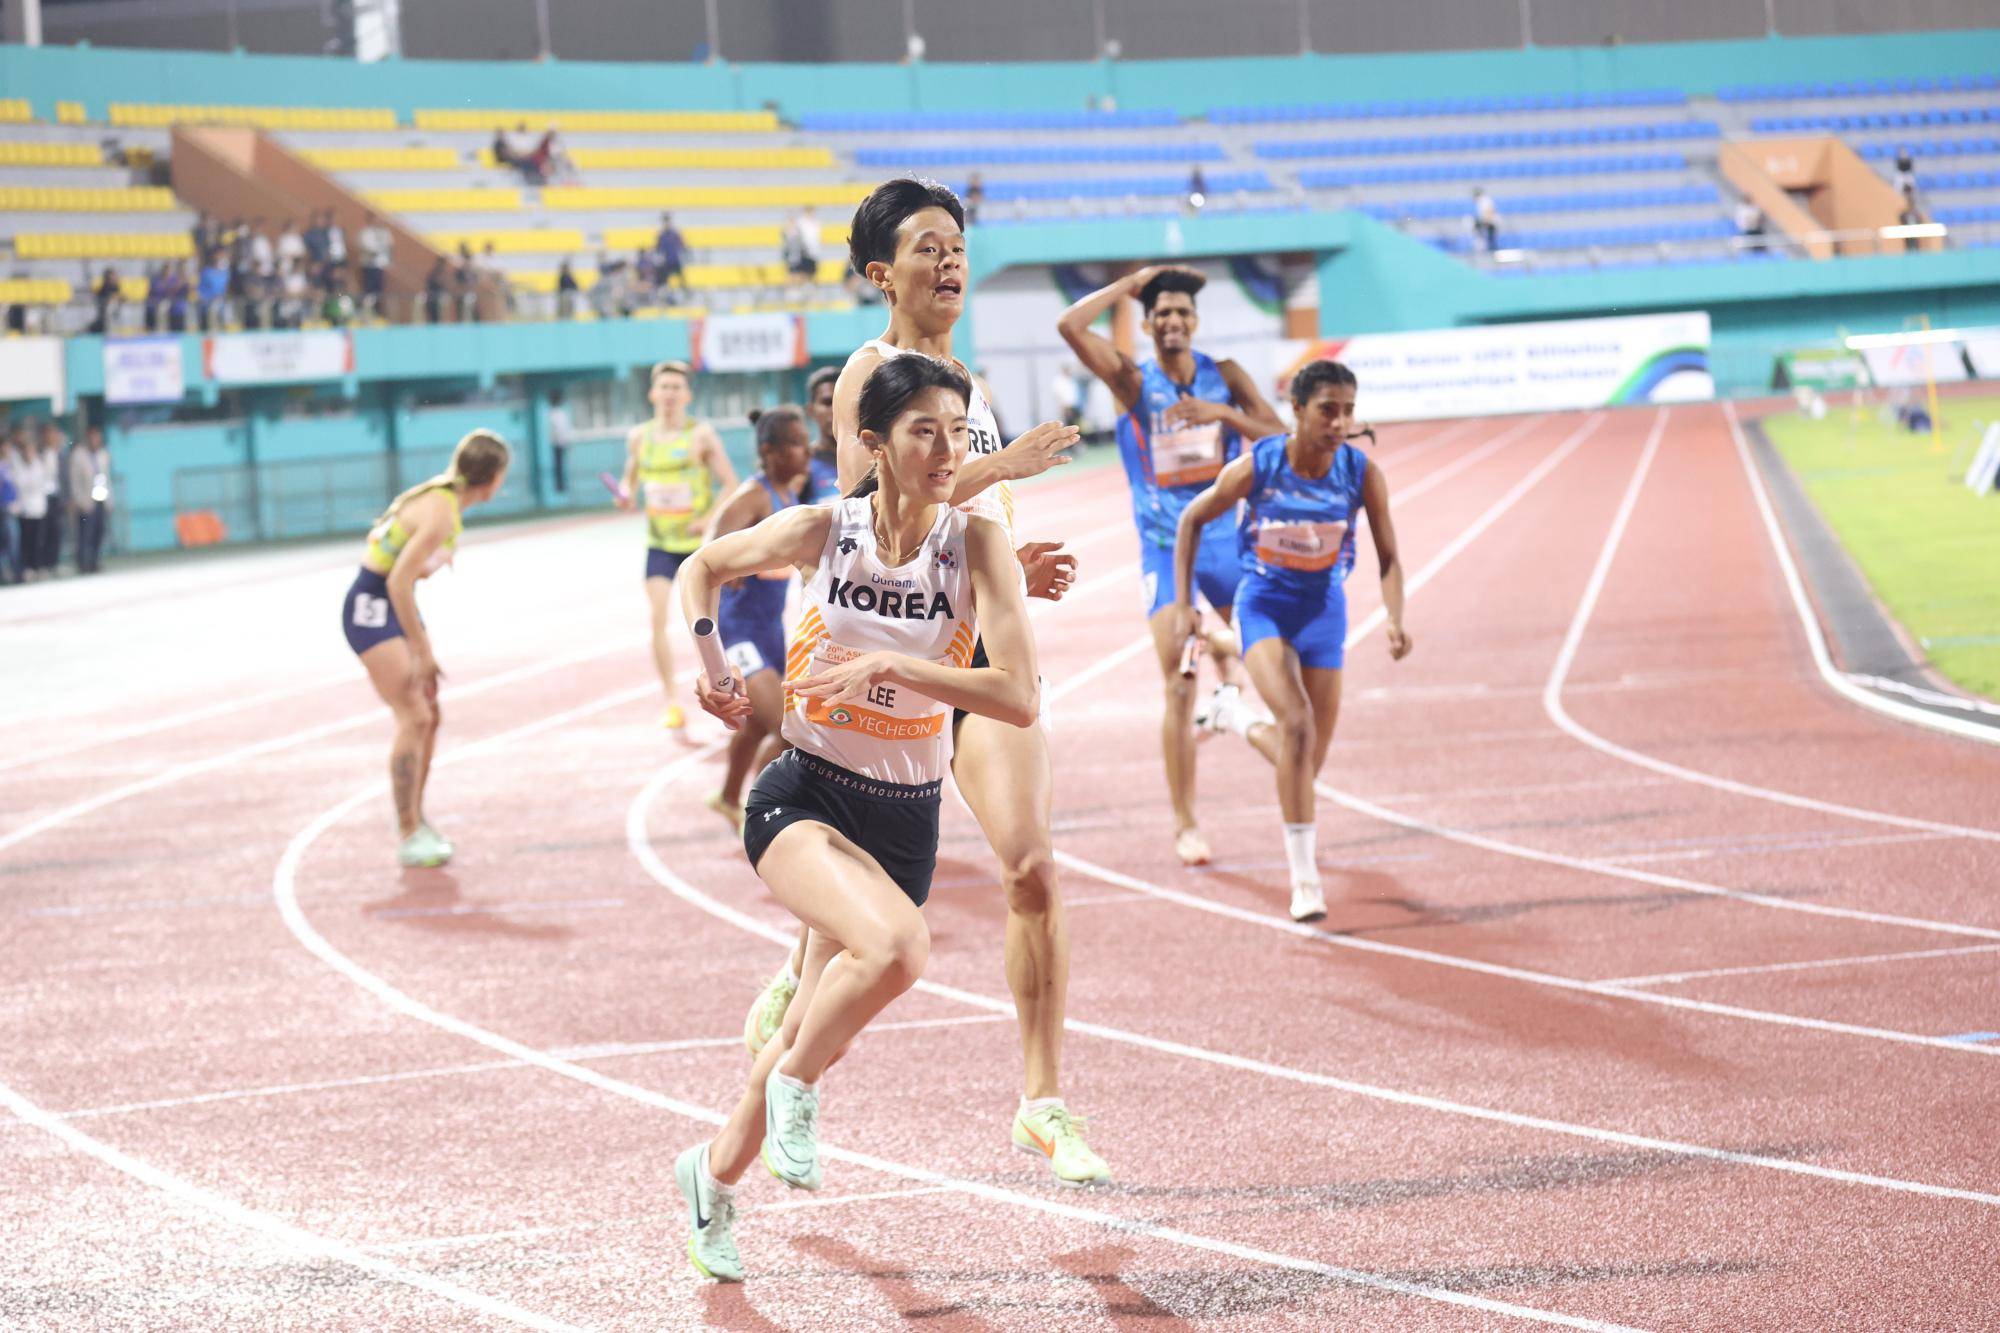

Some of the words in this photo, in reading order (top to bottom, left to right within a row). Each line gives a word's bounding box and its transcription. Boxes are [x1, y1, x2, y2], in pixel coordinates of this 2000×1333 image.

[967, 428, 997, 454] REA
[828, 576, 954, 620] KOREA
[867, 685, 896, 709] LEE
[857, 713, 932, 737] YECHEON
[850, 781, 901, 799] ARMOUR
